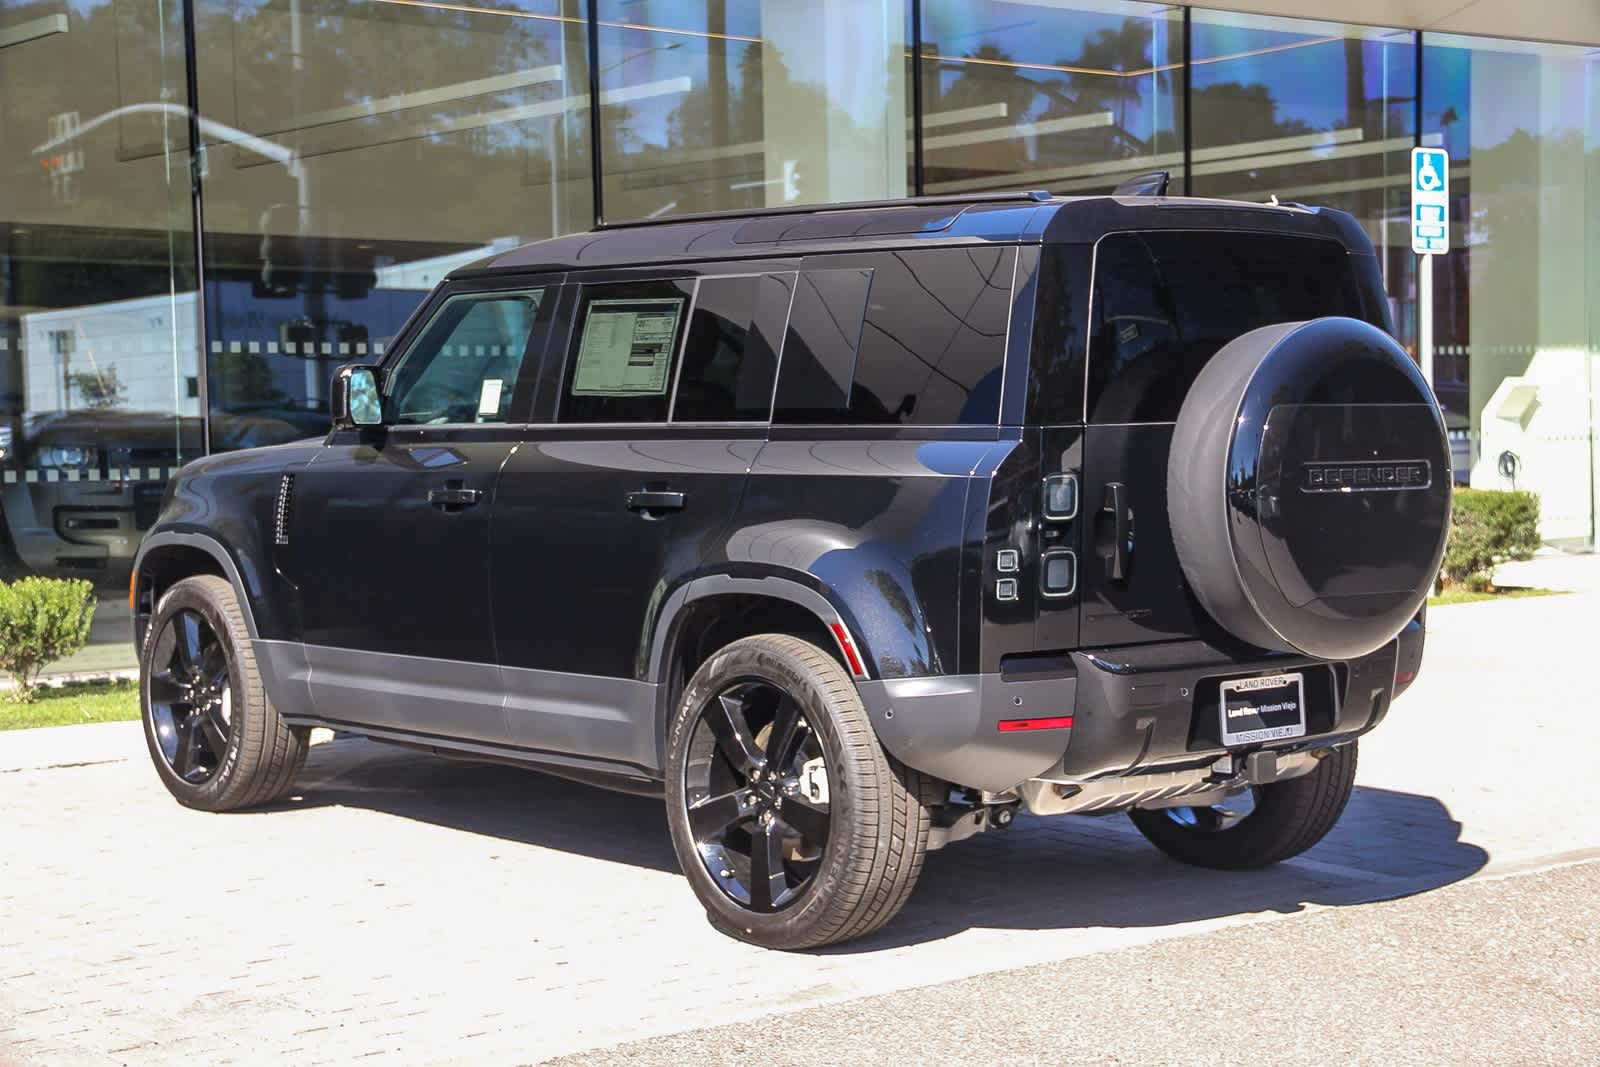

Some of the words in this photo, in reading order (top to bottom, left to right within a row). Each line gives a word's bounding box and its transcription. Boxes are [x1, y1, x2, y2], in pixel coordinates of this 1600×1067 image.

[1308, 466, 1422, 485] DEFENDER
[1239, 680, 1258, 689] LAND
[1260, 677, 1284, 687] ROVER
[1260, 704, 1282, 713] Mission
[1282, 701, 1297, 712] Viejo
[1236, 731, 1270, 743] MISSION
[1270, 728, 1293, 738] VIEJO
